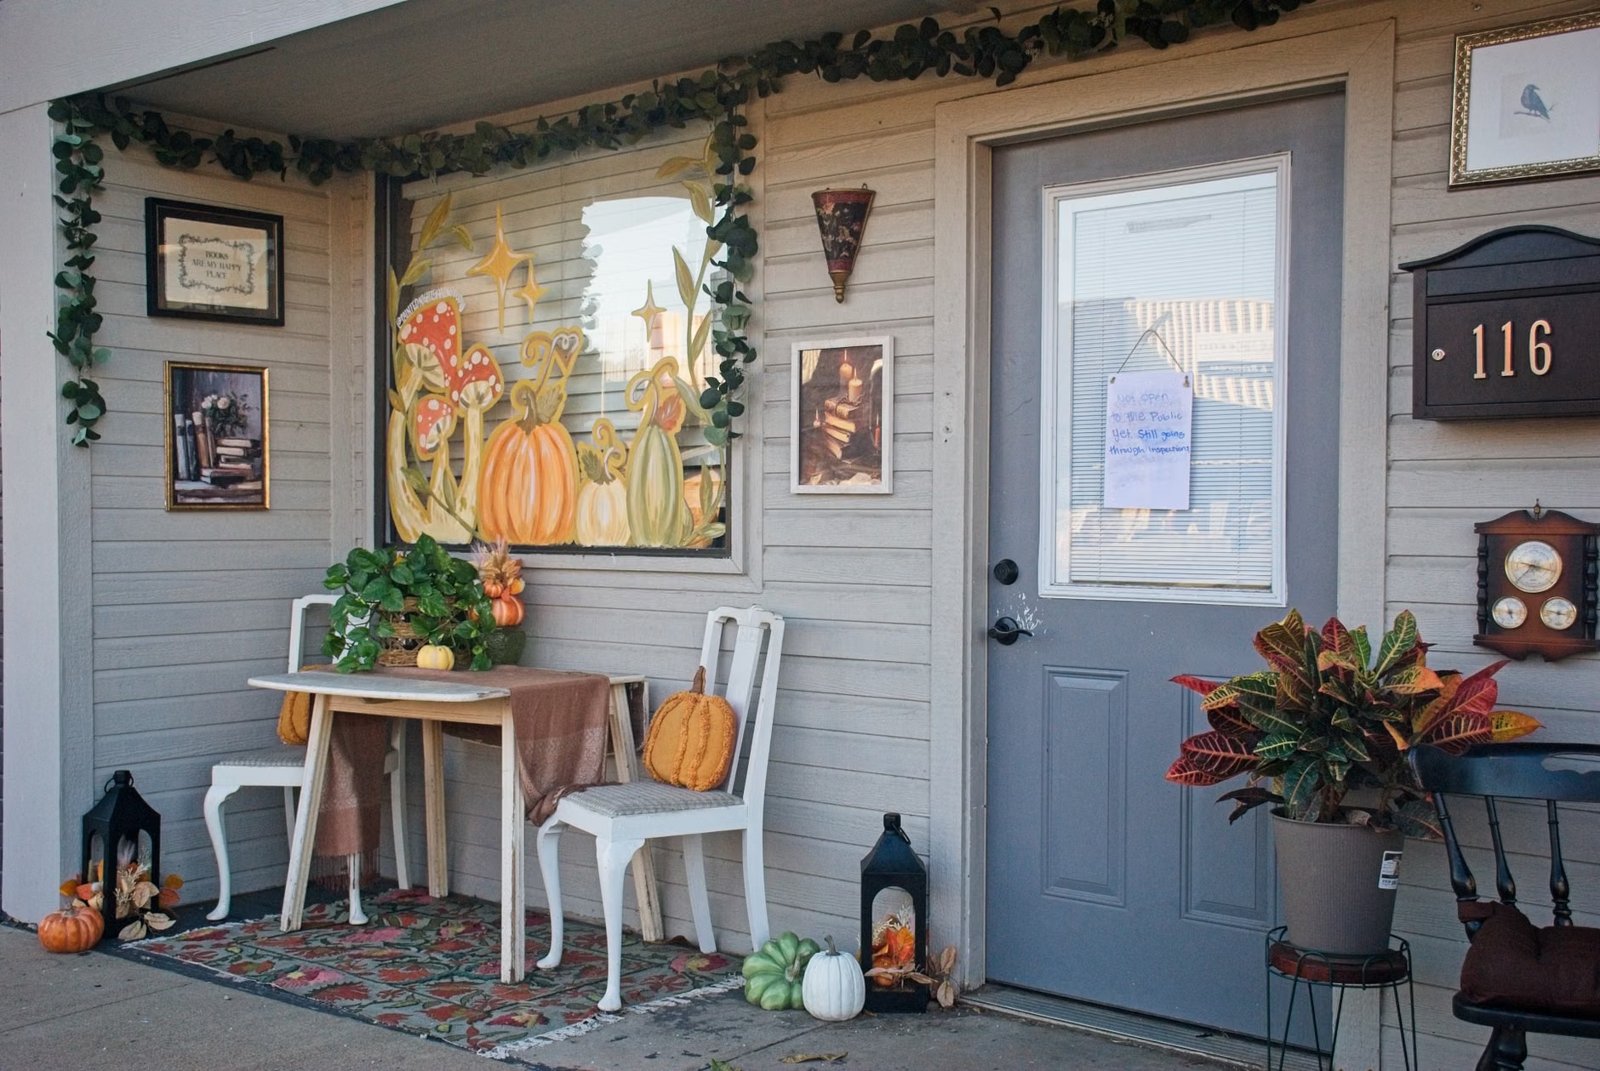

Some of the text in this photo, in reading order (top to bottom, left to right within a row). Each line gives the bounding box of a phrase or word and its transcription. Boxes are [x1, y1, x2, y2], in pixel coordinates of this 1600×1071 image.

[205, 251, 229, 260] BOOKS
[191, 259, 241, 272] ARE MY HAPPY
[1472, 319, 1553, 379] 116
[1161, 431, 1186, 442] going
[1109, 445, 1146, 456] through
